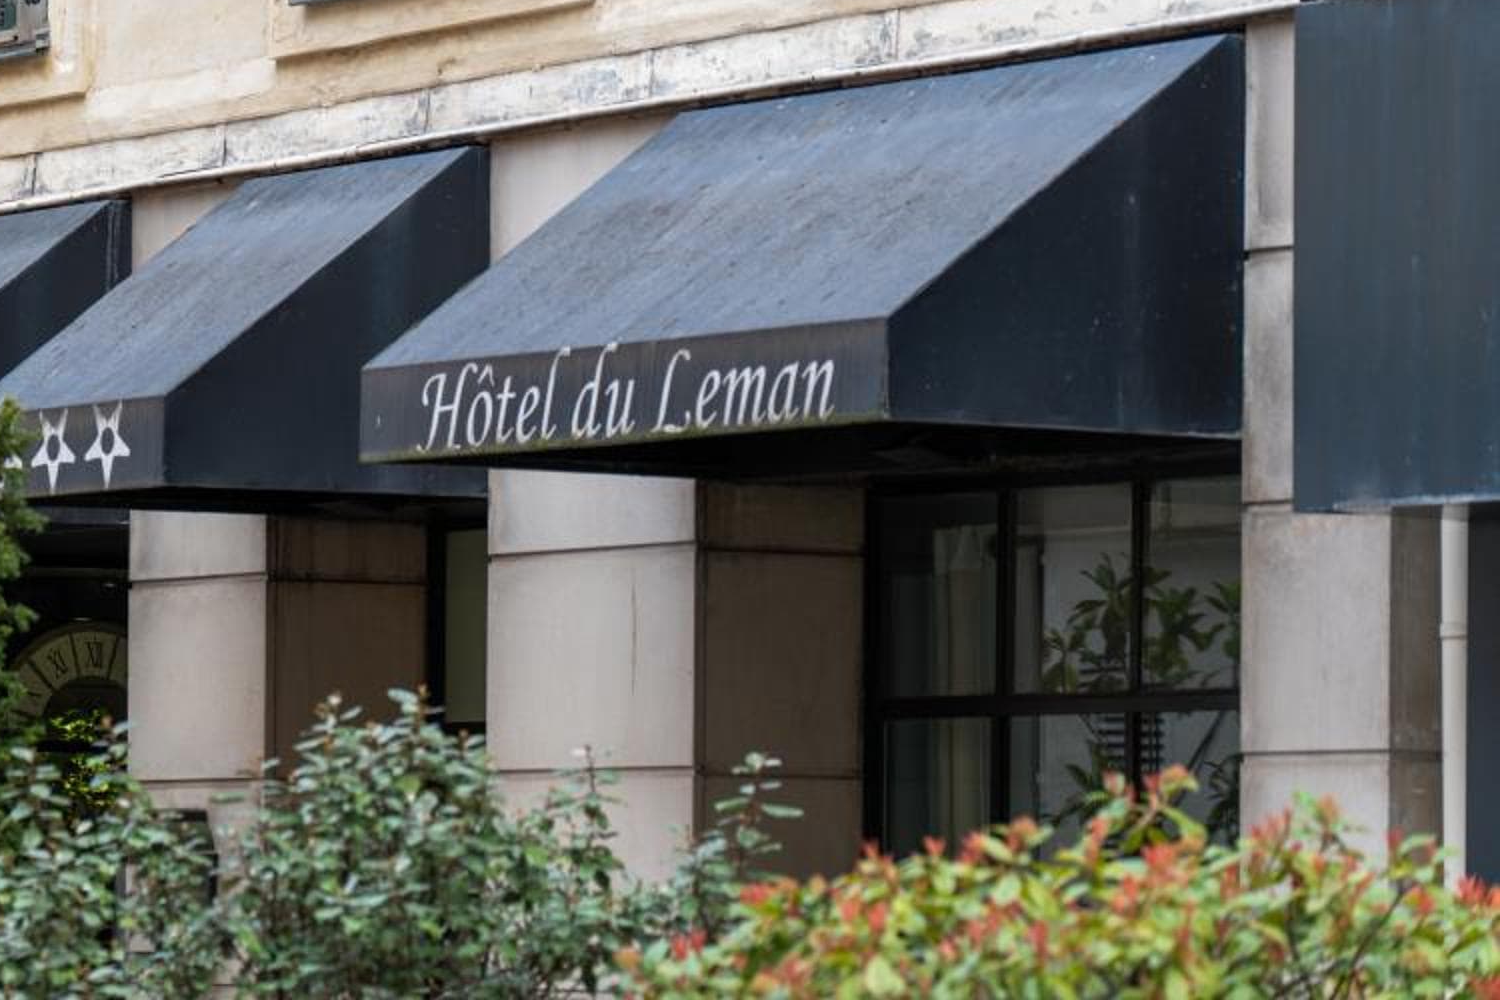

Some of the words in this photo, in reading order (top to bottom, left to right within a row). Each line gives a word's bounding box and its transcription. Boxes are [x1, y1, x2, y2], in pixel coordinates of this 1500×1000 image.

[416, 345, 571, 453] Hôtel
[571, 341, 636, 440] du
[650, 348, 836, 433] Leman
